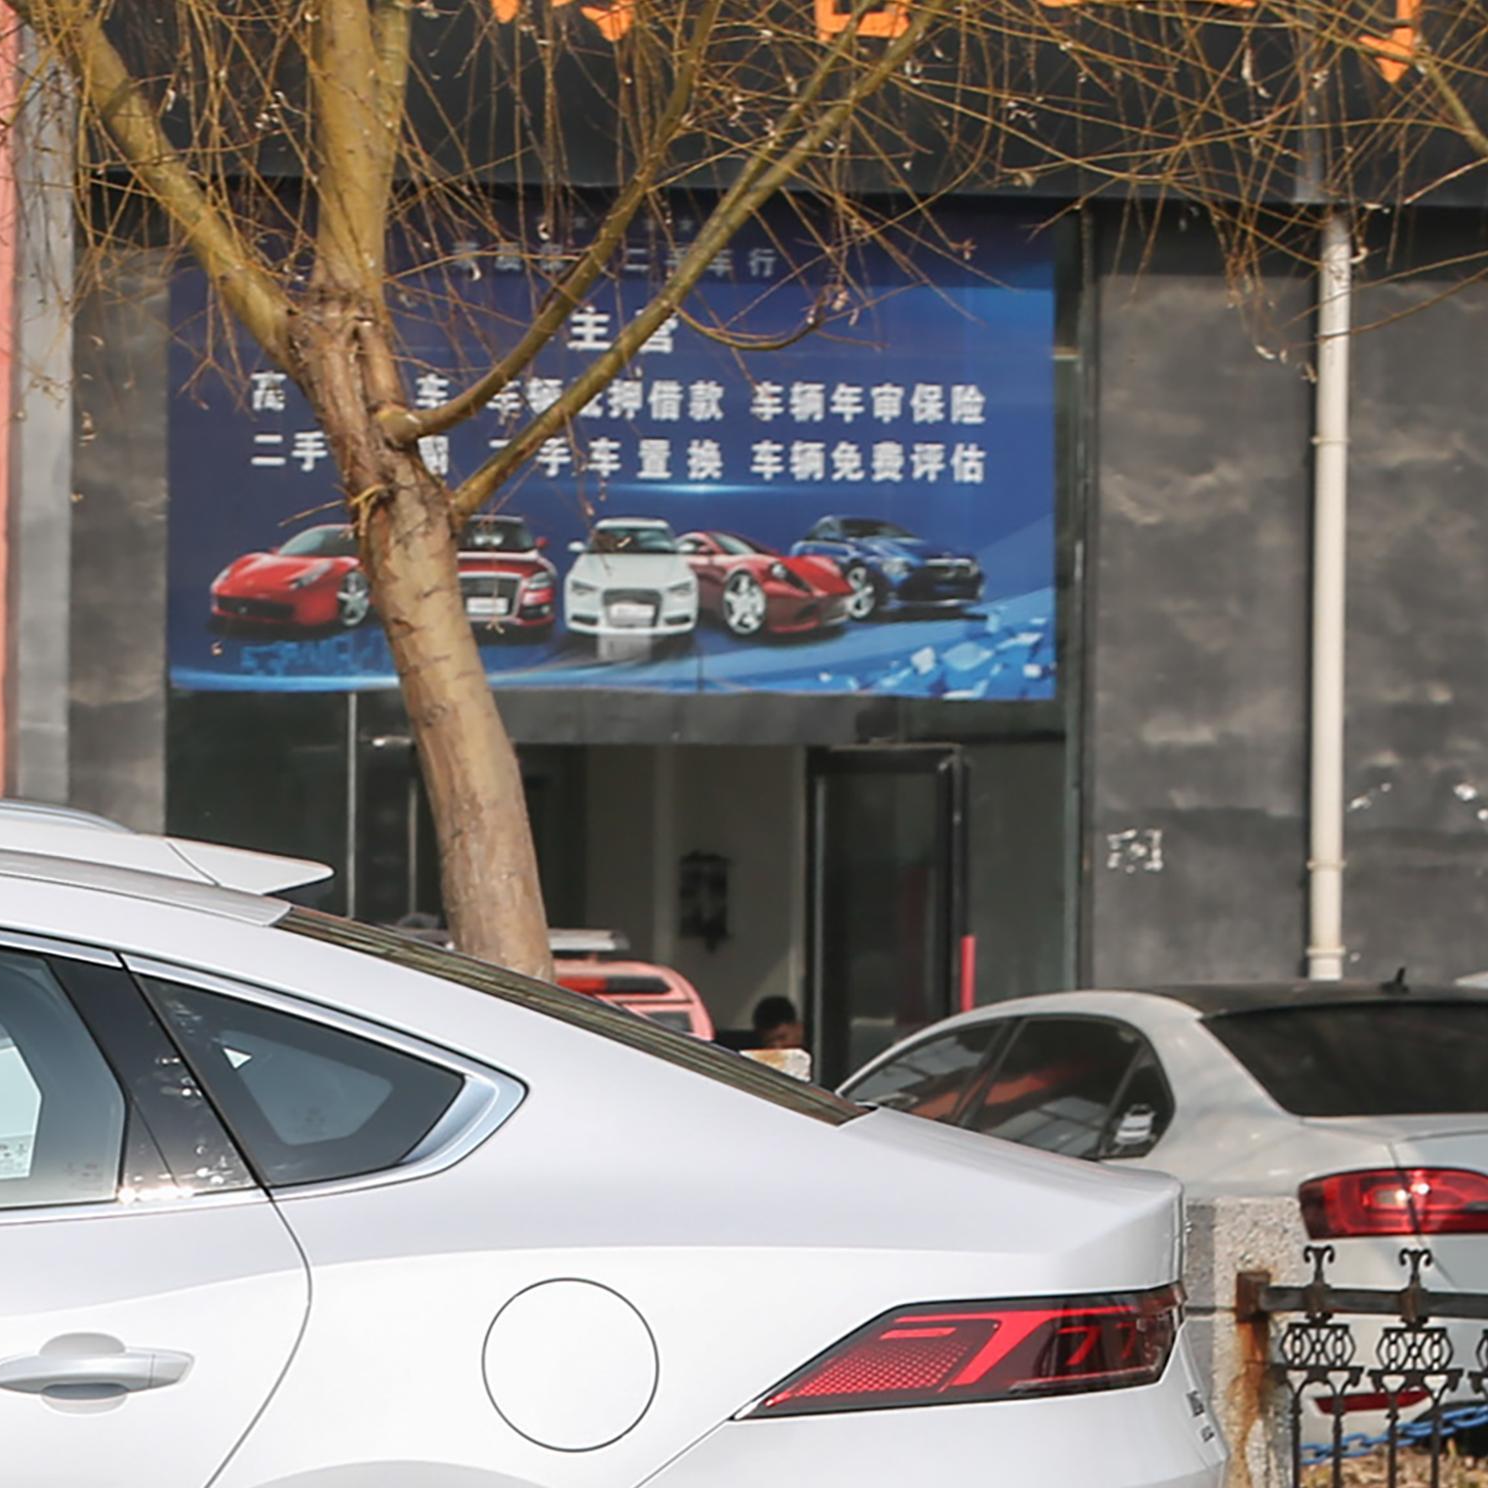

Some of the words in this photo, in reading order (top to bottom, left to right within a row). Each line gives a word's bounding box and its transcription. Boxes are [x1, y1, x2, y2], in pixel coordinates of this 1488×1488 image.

[486, 376, 724, 421] 车辆押借款
[750, 380, 987, 424] 车辆年审保险
[489, 436, 724, 480] 手车置换
[750, 438, 987, 484] 车辆免费评估
